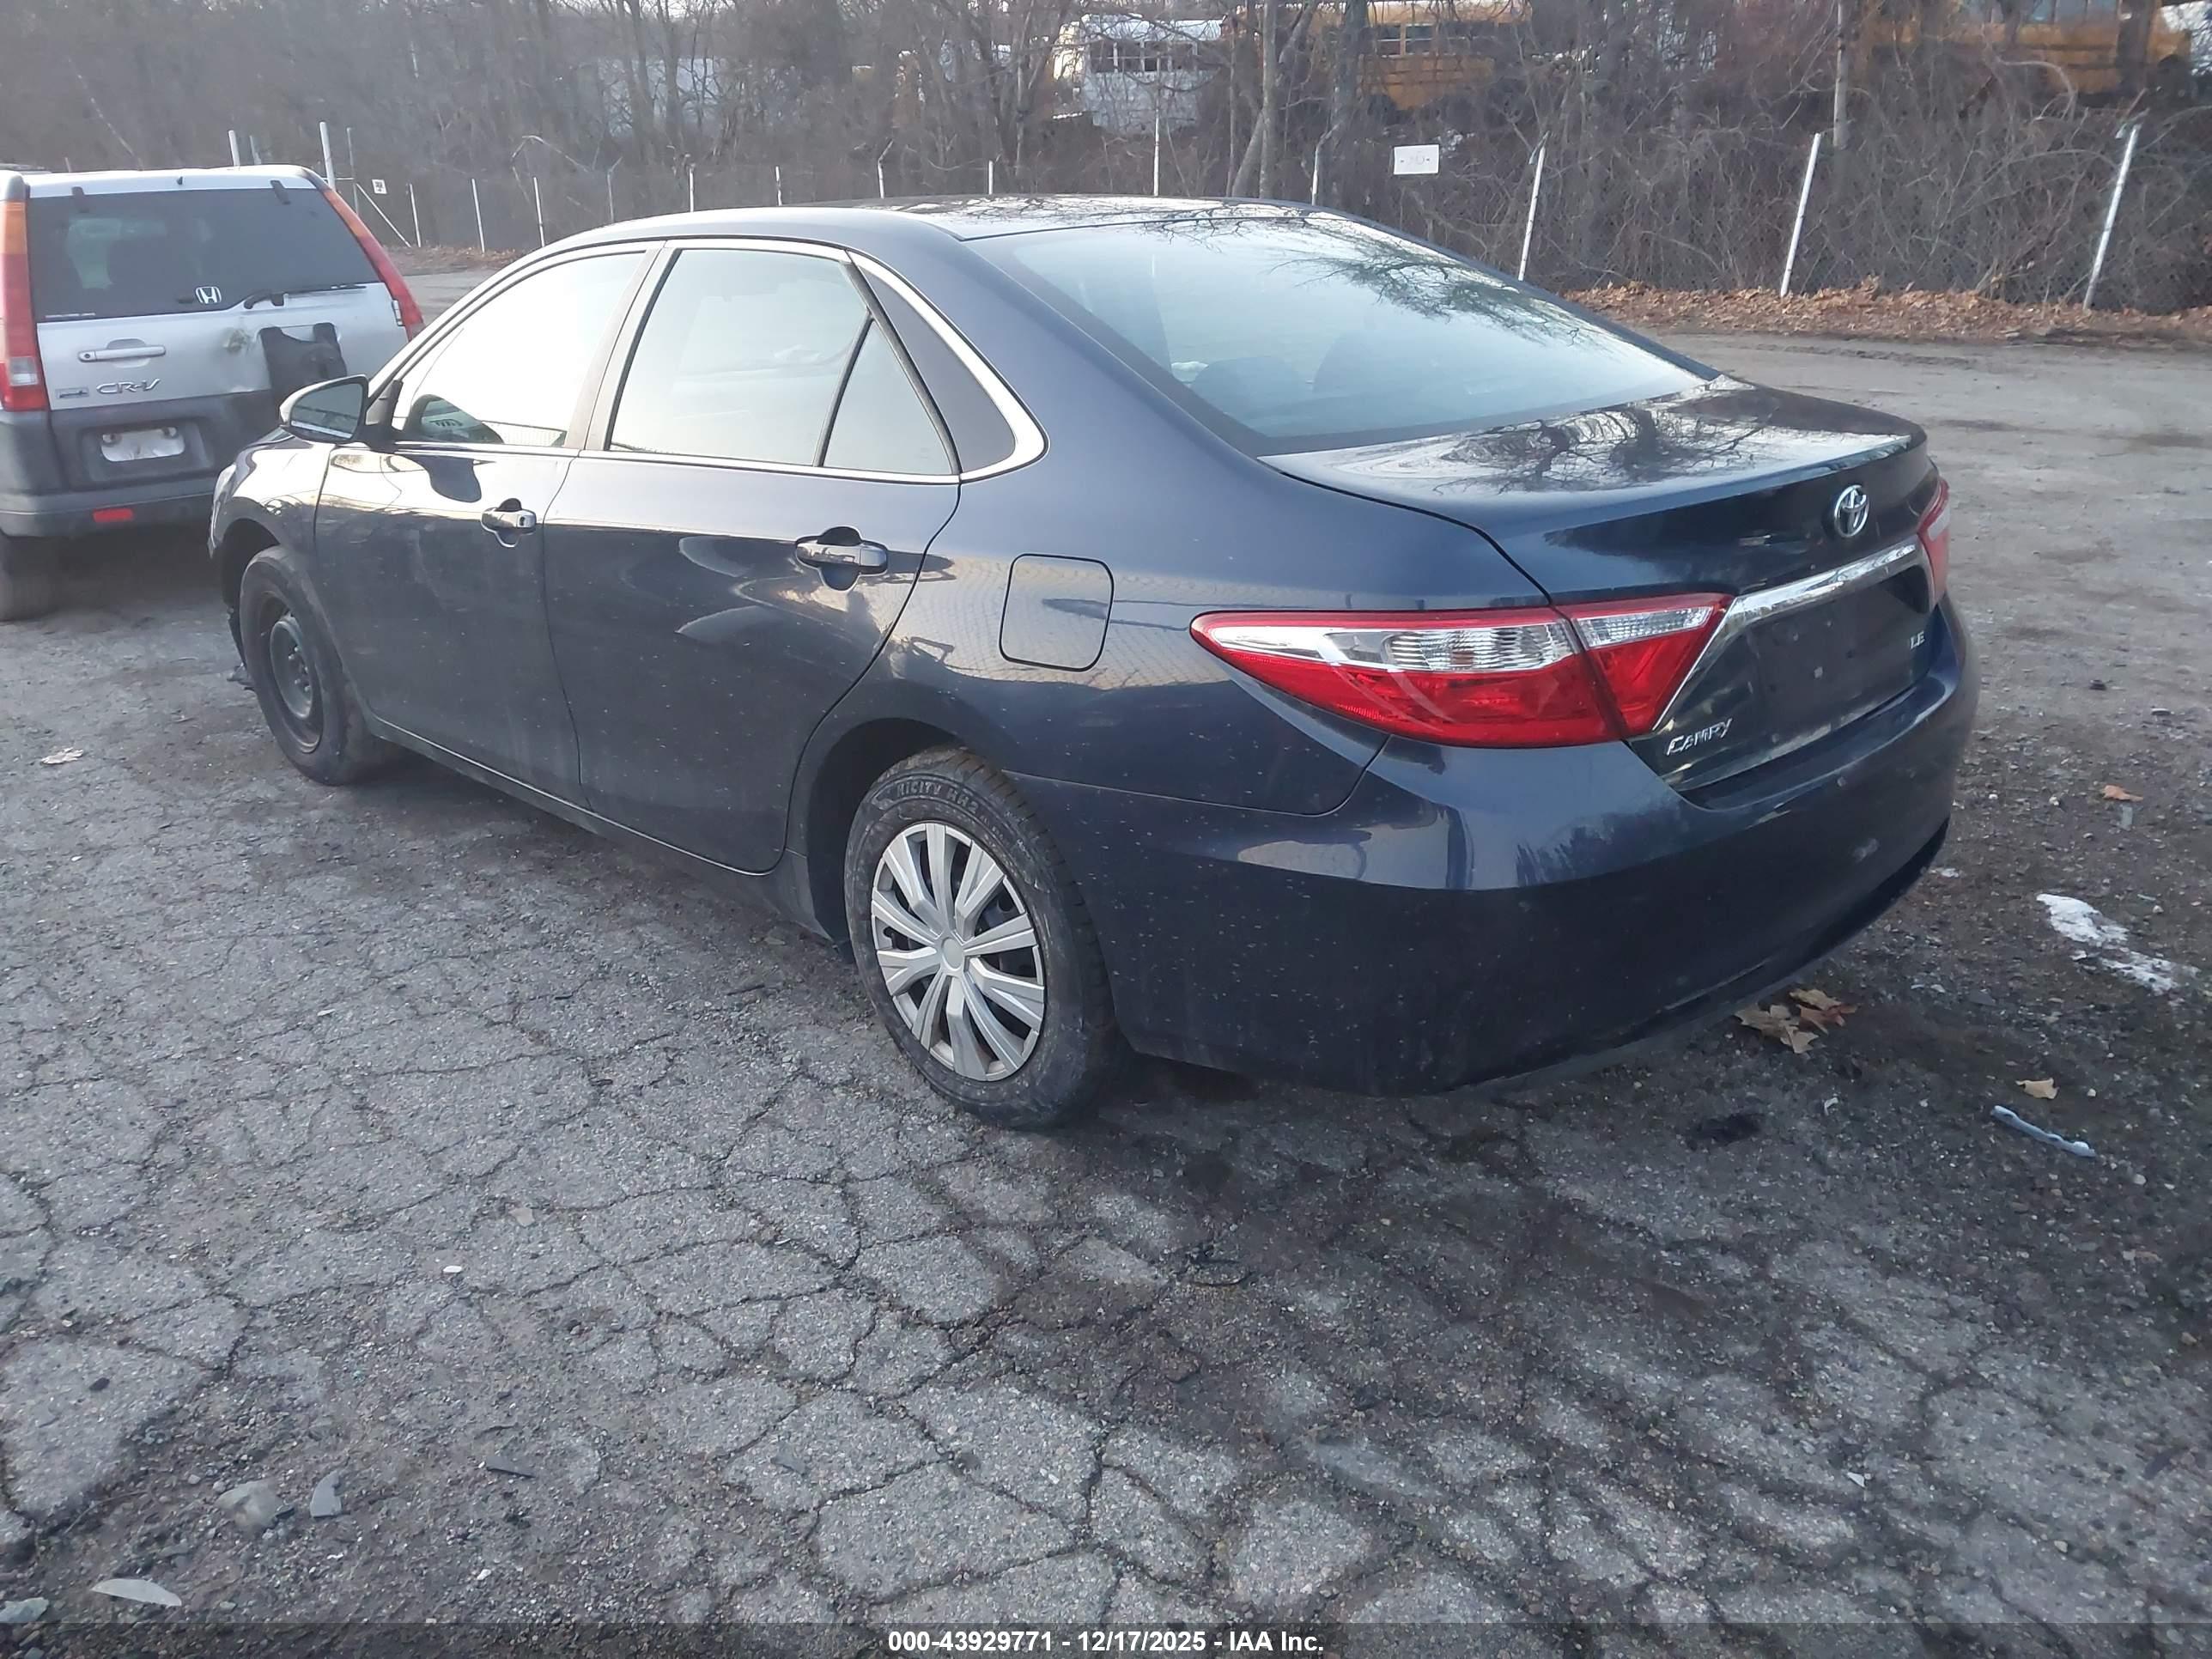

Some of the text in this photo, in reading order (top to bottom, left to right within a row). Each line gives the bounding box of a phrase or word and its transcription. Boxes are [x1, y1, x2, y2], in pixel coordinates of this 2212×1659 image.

[96, 378, 161, 395] CR-V
[1910, 630, 1925, 650] LE
[1667, 718, 1733, 756] CAMRY
